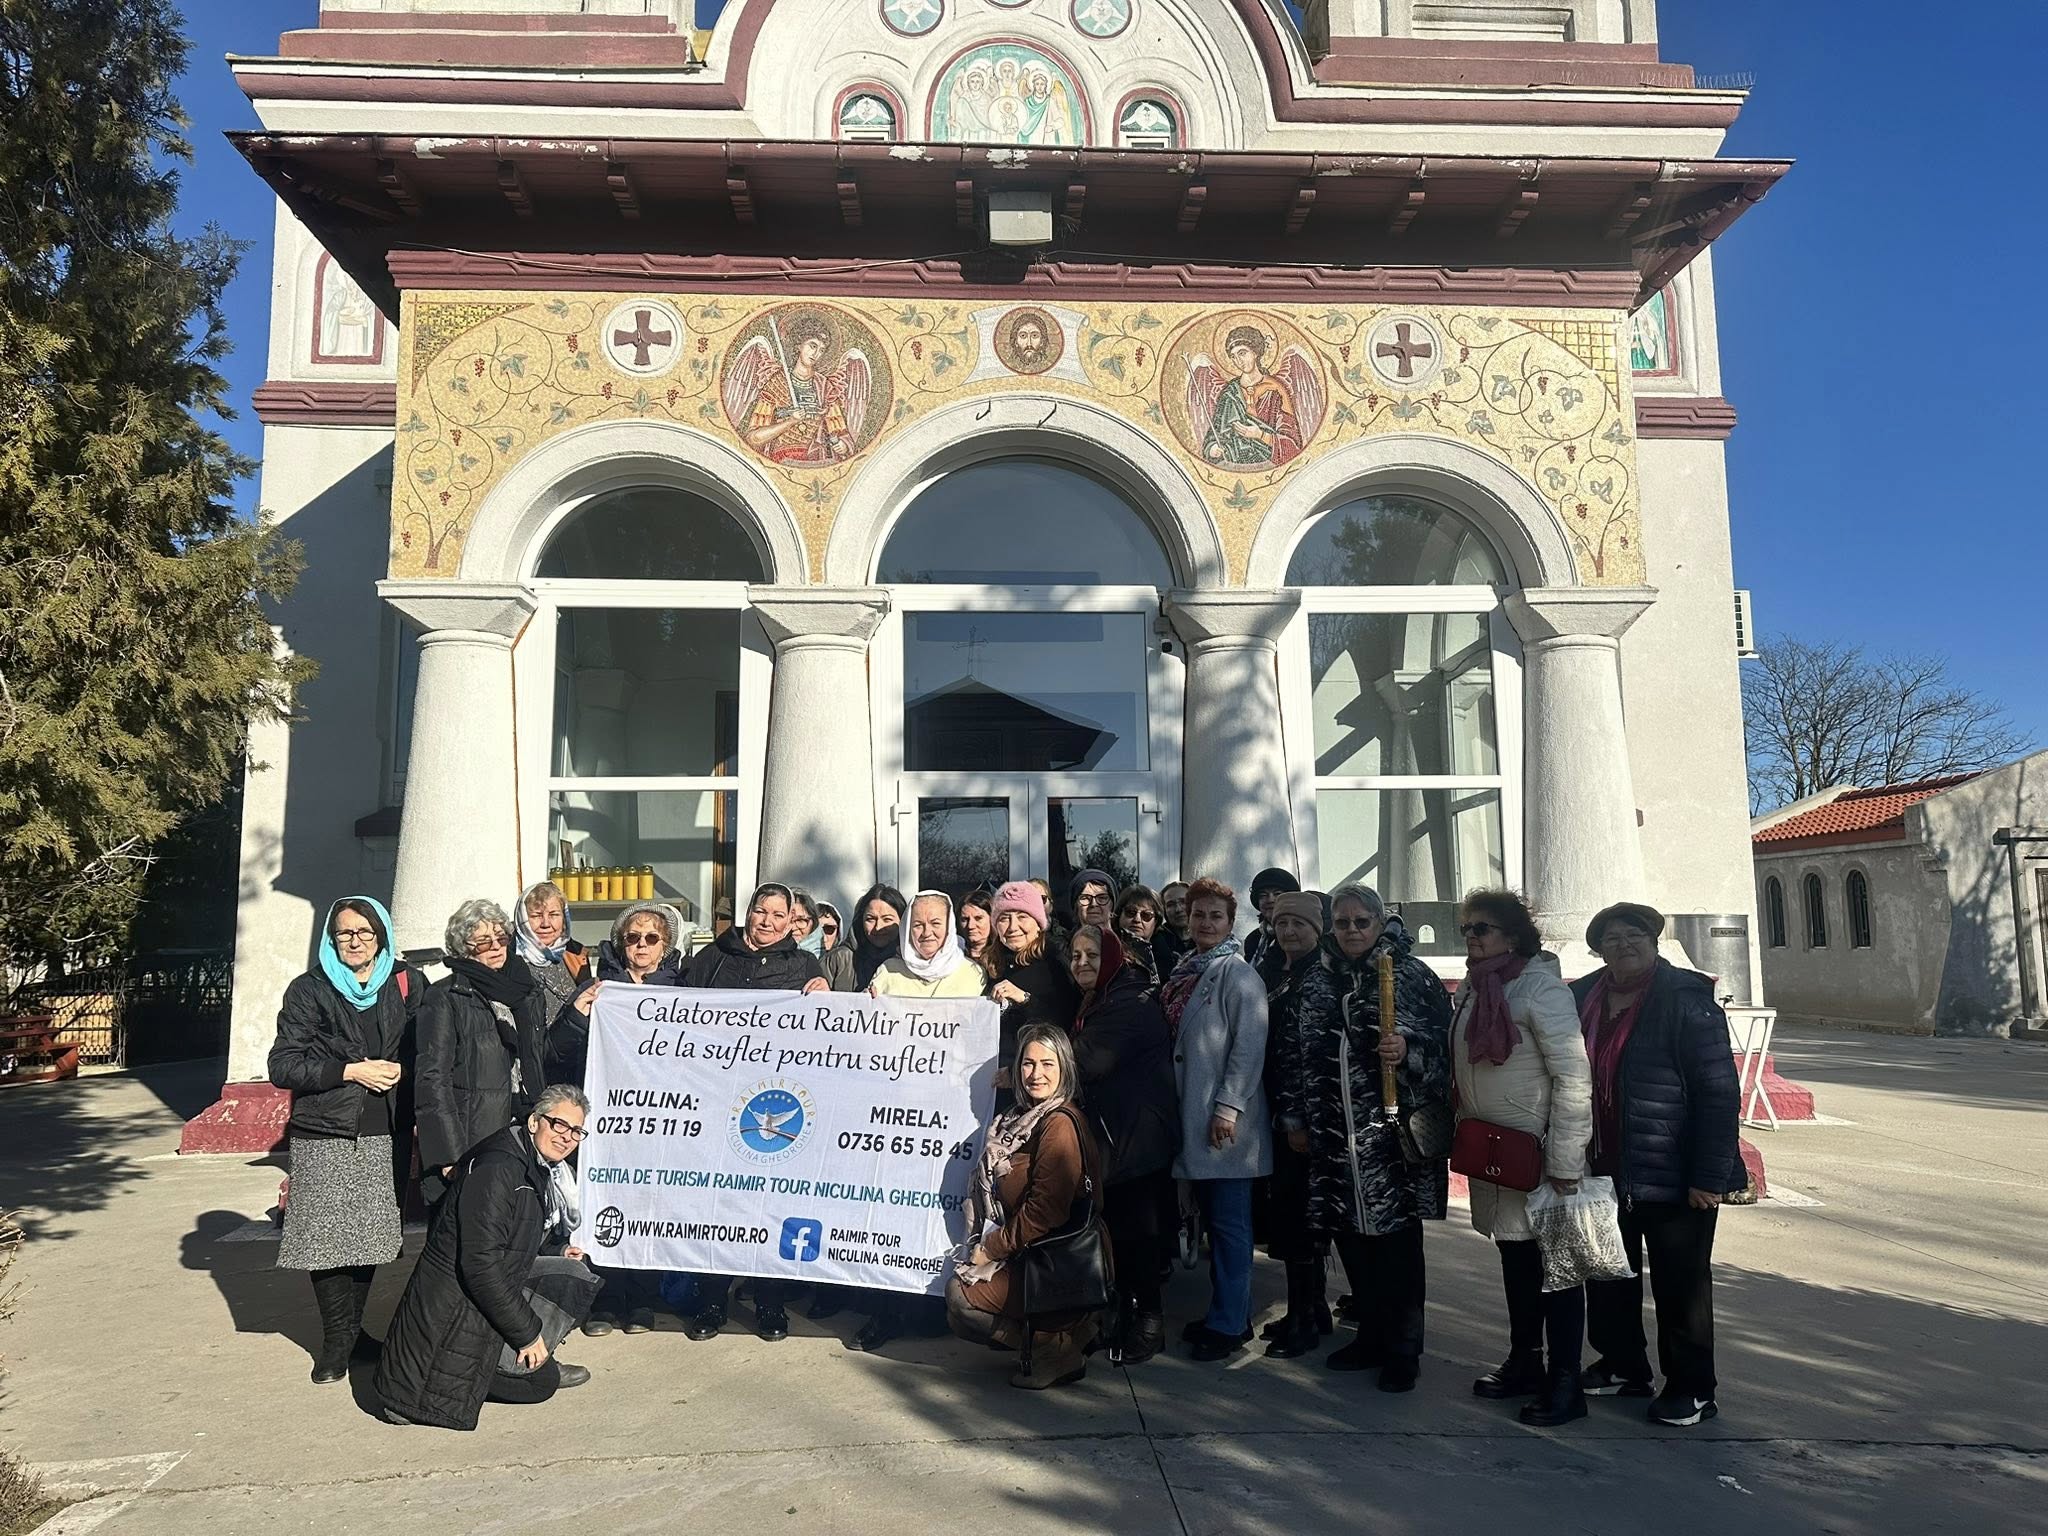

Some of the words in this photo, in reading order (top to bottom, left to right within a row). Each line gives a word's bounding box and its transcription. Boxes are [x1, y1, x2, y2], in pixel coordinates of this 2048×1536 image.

[636, 997, 771, 1028] Calatoreste
[777, 1013, 806, 1030] cu
[814, 1007, 899, 1036] RaiMir
[905, 1013, 960, 1039] Tour
[638, 1028, 668, 1057] de
[675, 1031, 696, 1058] la
[702, 1034, 772, 1070] suflet
[776, 1044, 862, 1073] pentru
[869, 1044, 946, 1081] suflet!
[607, 1089, 700, 1111] NICULINA:
[732, 1078, 785, 1114] RAIMIR
[791, 1082, 816, 1118] TOUR
[596, 1116, 634, 1134] 0723
[639, 1117, 657, 1135] 15
[662, 1118, 678, 1136] 11
[683, 1119, 702, 1137] 19
[869, 1105, 949, 1130] MIRELA:
[838, 1131, 885, 1153] 0736
[890, 1135, 915, 1155] 65
[919, 1138, 944, 1158] 58
[948, 1141, 974, 1161] 45
[633, 1168, 653, 1185] DE
[656, 1169, 710, 1188] TURISM
[712, 1173, 766, 1192] RAIMIR
[769, 1177, 811, 1196] TOUR
[814, 1181, 885, 1204] NICULINA
[889, 1188, 968, 1212] GHEORGH
[627, 1219, 769, 1245] WWW.RAIMIRTOUR.RO
[829, 1227, 868, 1244] RAIMIR
[872, 1231, 901, 1248] TOUR
[827, 1247, 880, 1265] NICULINA
[882, 1254, 943, 1273] GHEORGHE
